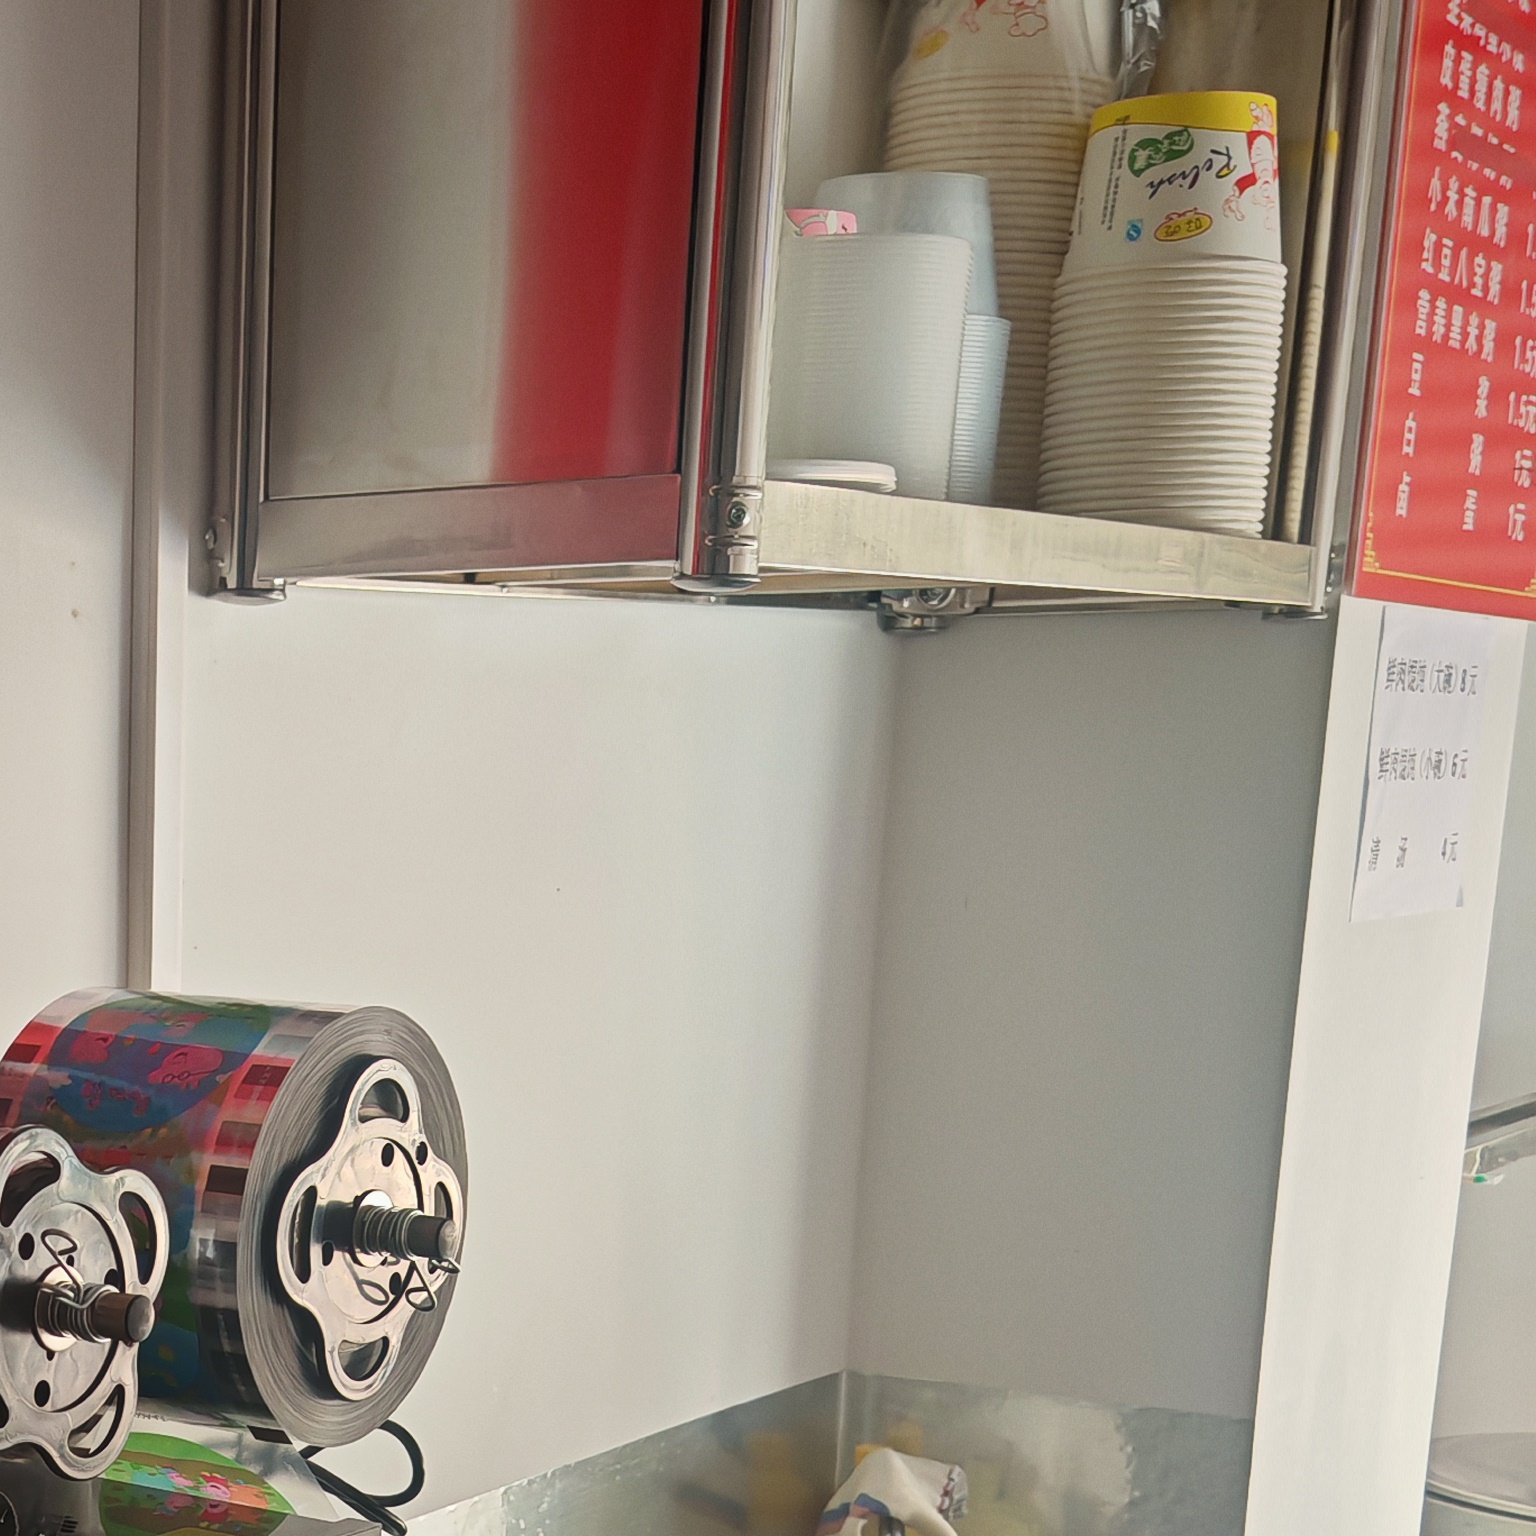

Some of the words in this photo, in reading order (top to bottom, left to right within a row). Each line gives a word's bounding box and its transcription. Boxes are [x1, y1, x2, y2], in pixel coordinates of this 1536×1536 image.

[1145, 145, 1238, 201] Relish
[1428, 166, 1510, 248] 小米南瓜粥
[1421, 227, 1504, 306] 红豆八宝粥
[1415, 288, 1497, 363] 营养黑米粥
